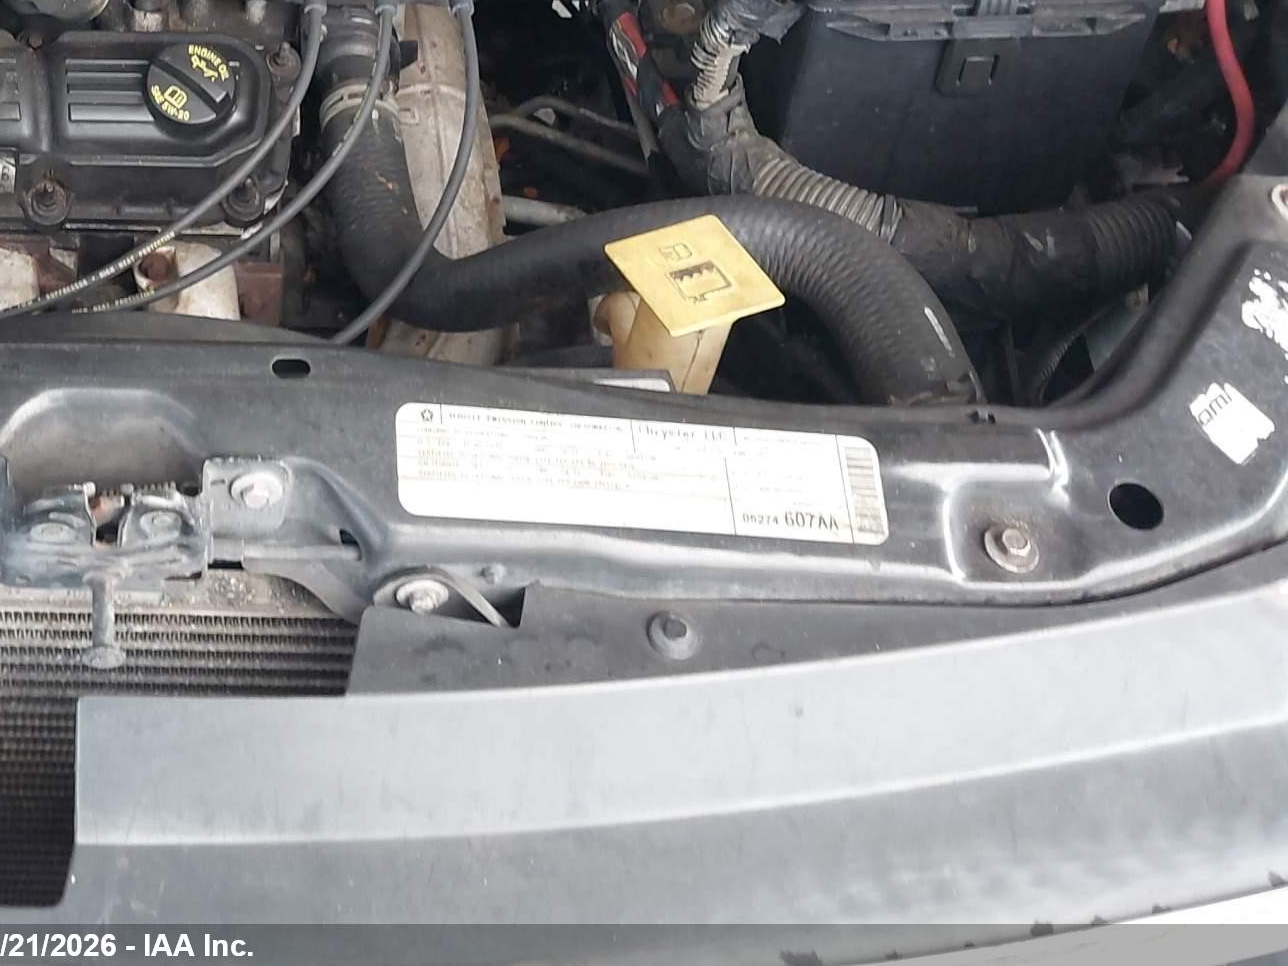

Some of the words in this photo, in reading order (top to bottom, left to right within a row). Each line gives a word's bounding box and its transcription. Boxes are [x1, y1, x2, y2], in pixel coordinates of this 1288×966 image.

[188, 44, 221, 67] ENGINE
[217, 64, 229, 82] OIL
[784, 510, 839, 531] 607AA
